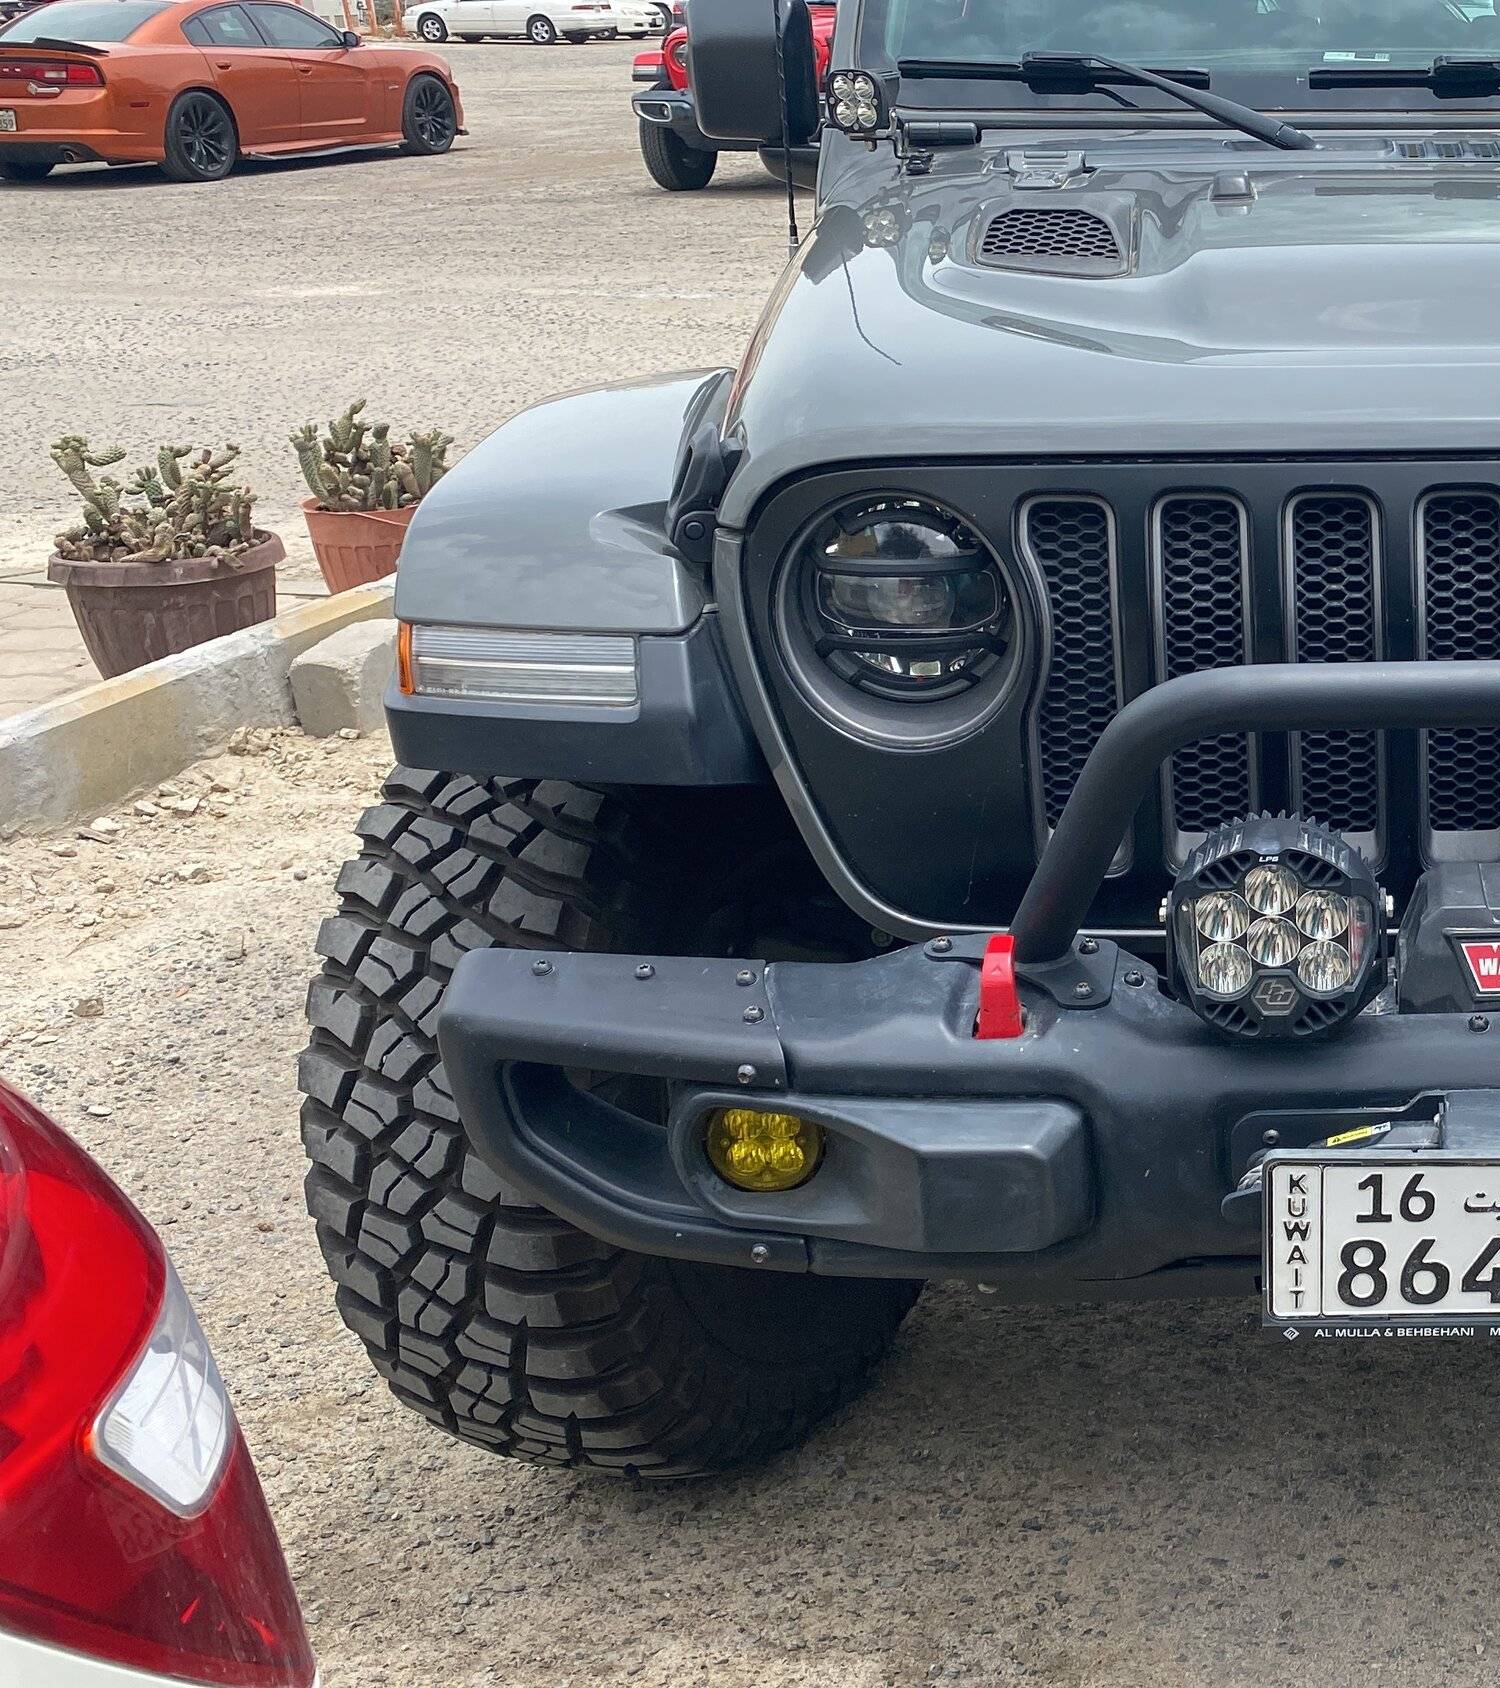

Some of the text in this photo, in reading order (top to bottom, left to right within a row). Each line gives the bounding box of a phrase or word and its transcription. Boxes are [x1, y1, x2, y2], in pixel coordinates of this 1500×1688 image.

[1356, 1173, 1436, 1223] 16
[1283, 1174, 1311, 1309] KUWAIT
[1315, 1327, 1474, 1338] AL MULLA & BEHBEHANI
